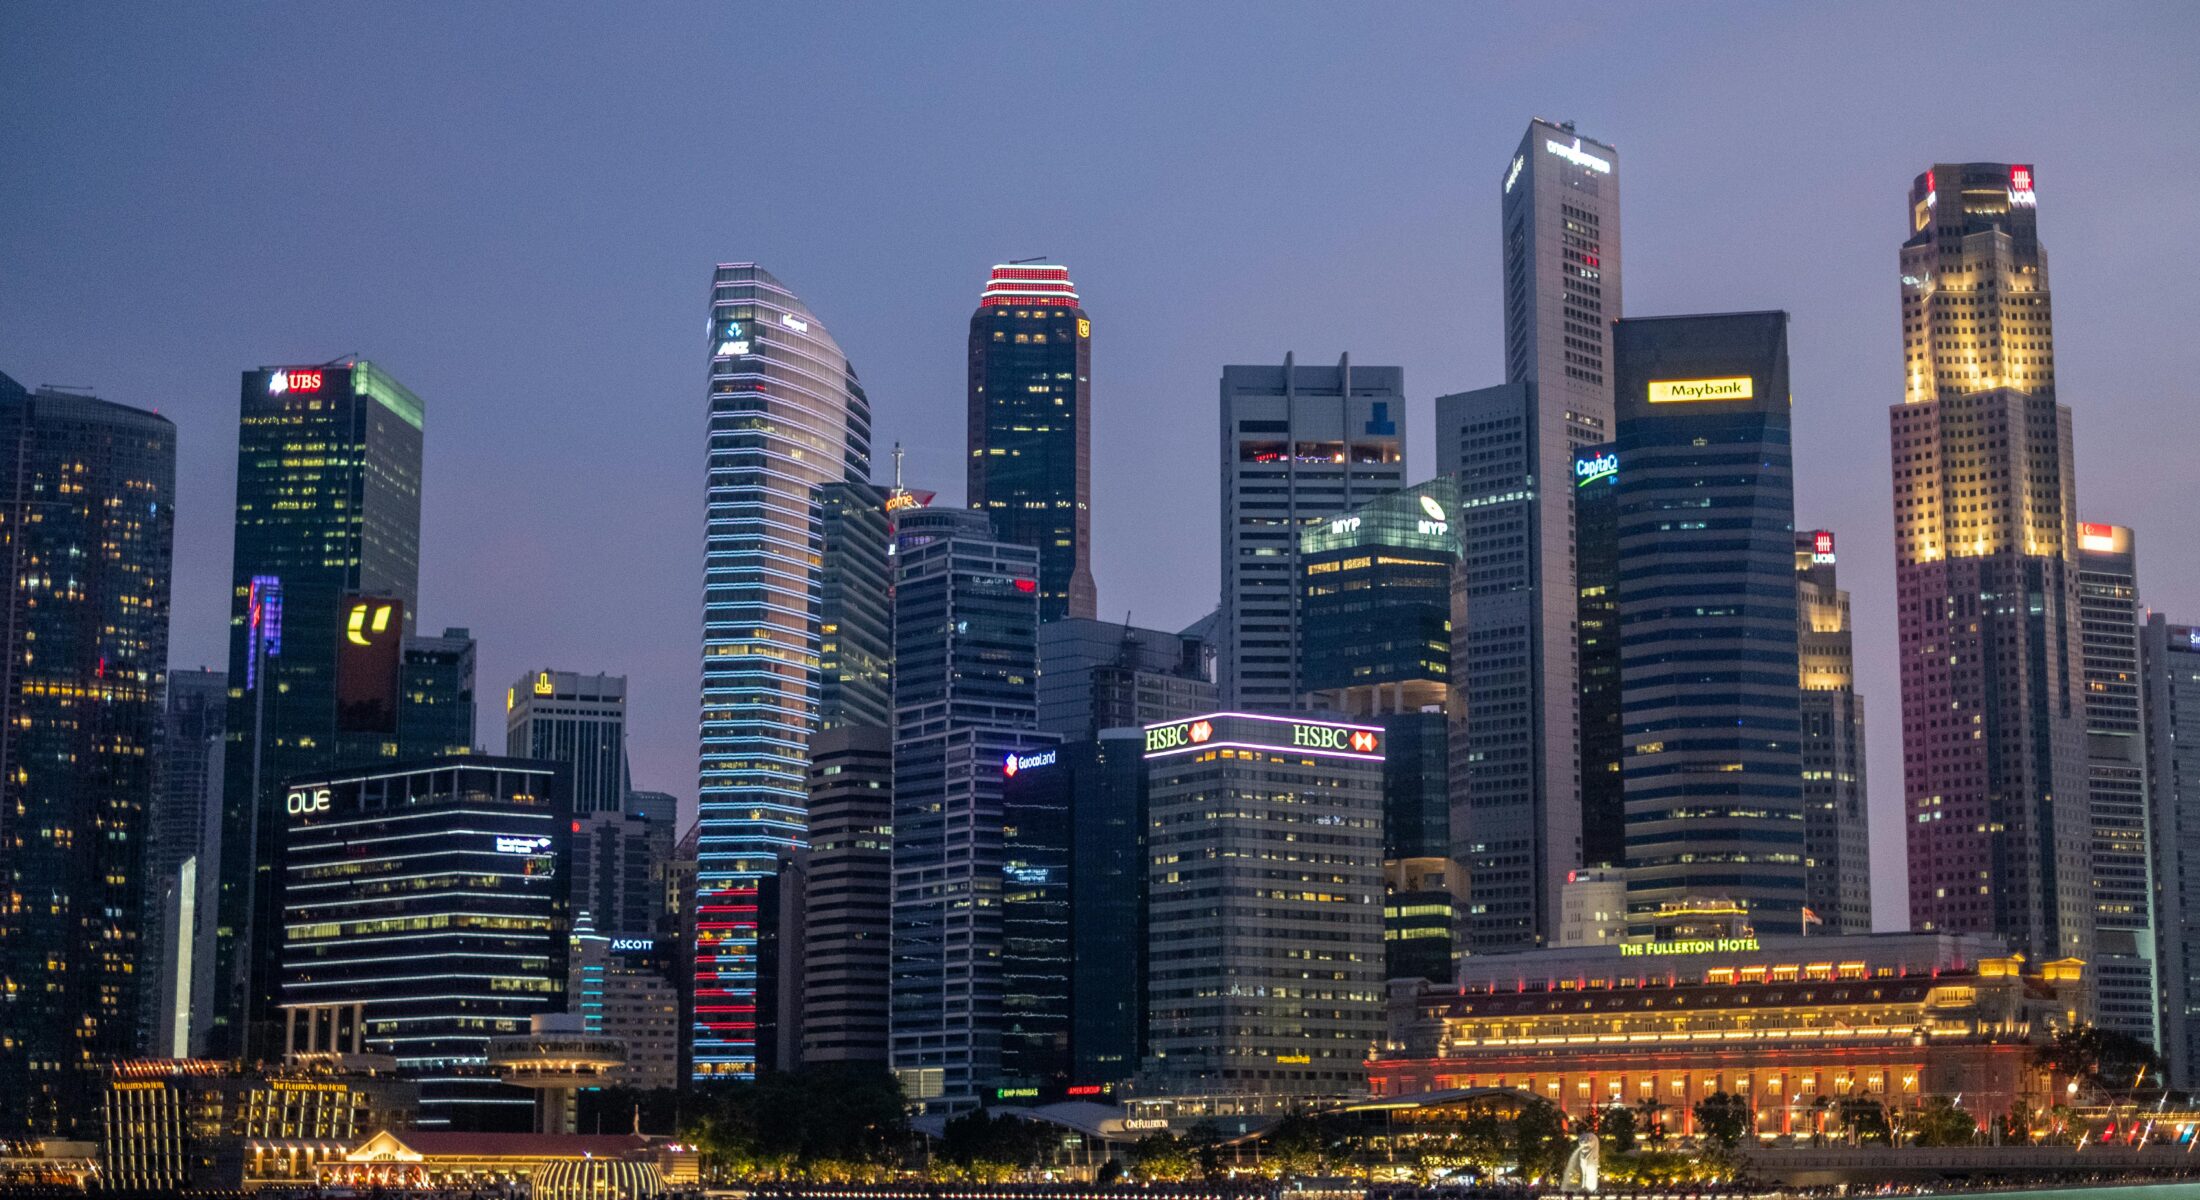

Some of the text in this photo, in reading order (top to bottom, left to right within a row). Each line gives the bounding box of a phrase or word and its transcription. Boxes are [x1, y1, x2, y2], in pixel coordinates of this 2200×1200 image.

[717, 341, 749, 355] ANZ
[289, 374, 321, 389] UBS
[1671, 382, 1742, 398] Maybank
[1332, 517, 1360, 534] MYP
[1418, 520, 1448, 535] MYP
[1813, 553, 1836, 563] UOB
[1146, 724, 1189, 750] HSBC
[1293, 725, 1348, 749] HSBC
[288, 789, 331, 814] OUE
[612, 939, 654, 950] ASCOTT
[1620, 939, 1760, 956] THE FULLERTON HOTEL
[273, 1081, 284, 1090] THE
